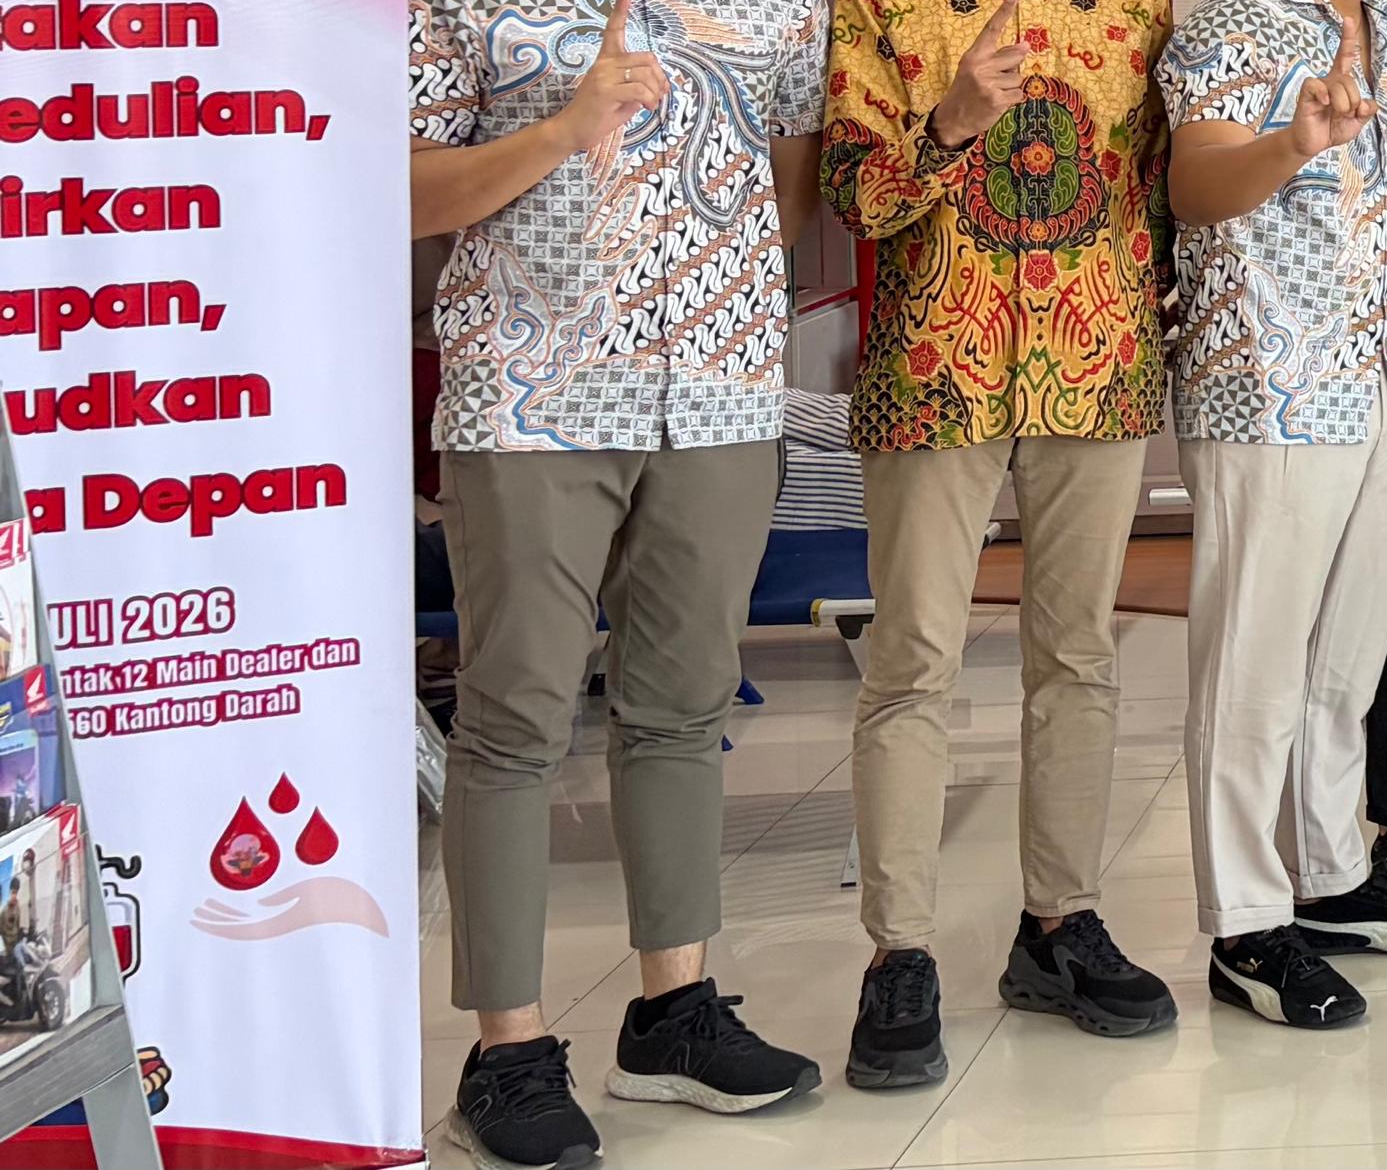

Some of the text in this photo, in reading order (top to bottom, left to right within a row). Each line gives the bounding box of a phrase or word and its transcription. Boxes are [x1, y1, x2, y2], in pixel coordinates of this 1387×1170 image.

[4, 370, 272, 436] udkan
[82, 463, 347, 538] Depan
[47, 586, 235, 651] ULI 2026
[60, 638, 361, 698] ntak 12 Main Dealer dan
[111, 695, 220, 737] Kantong
[221, 683, 301, 722] Darah
